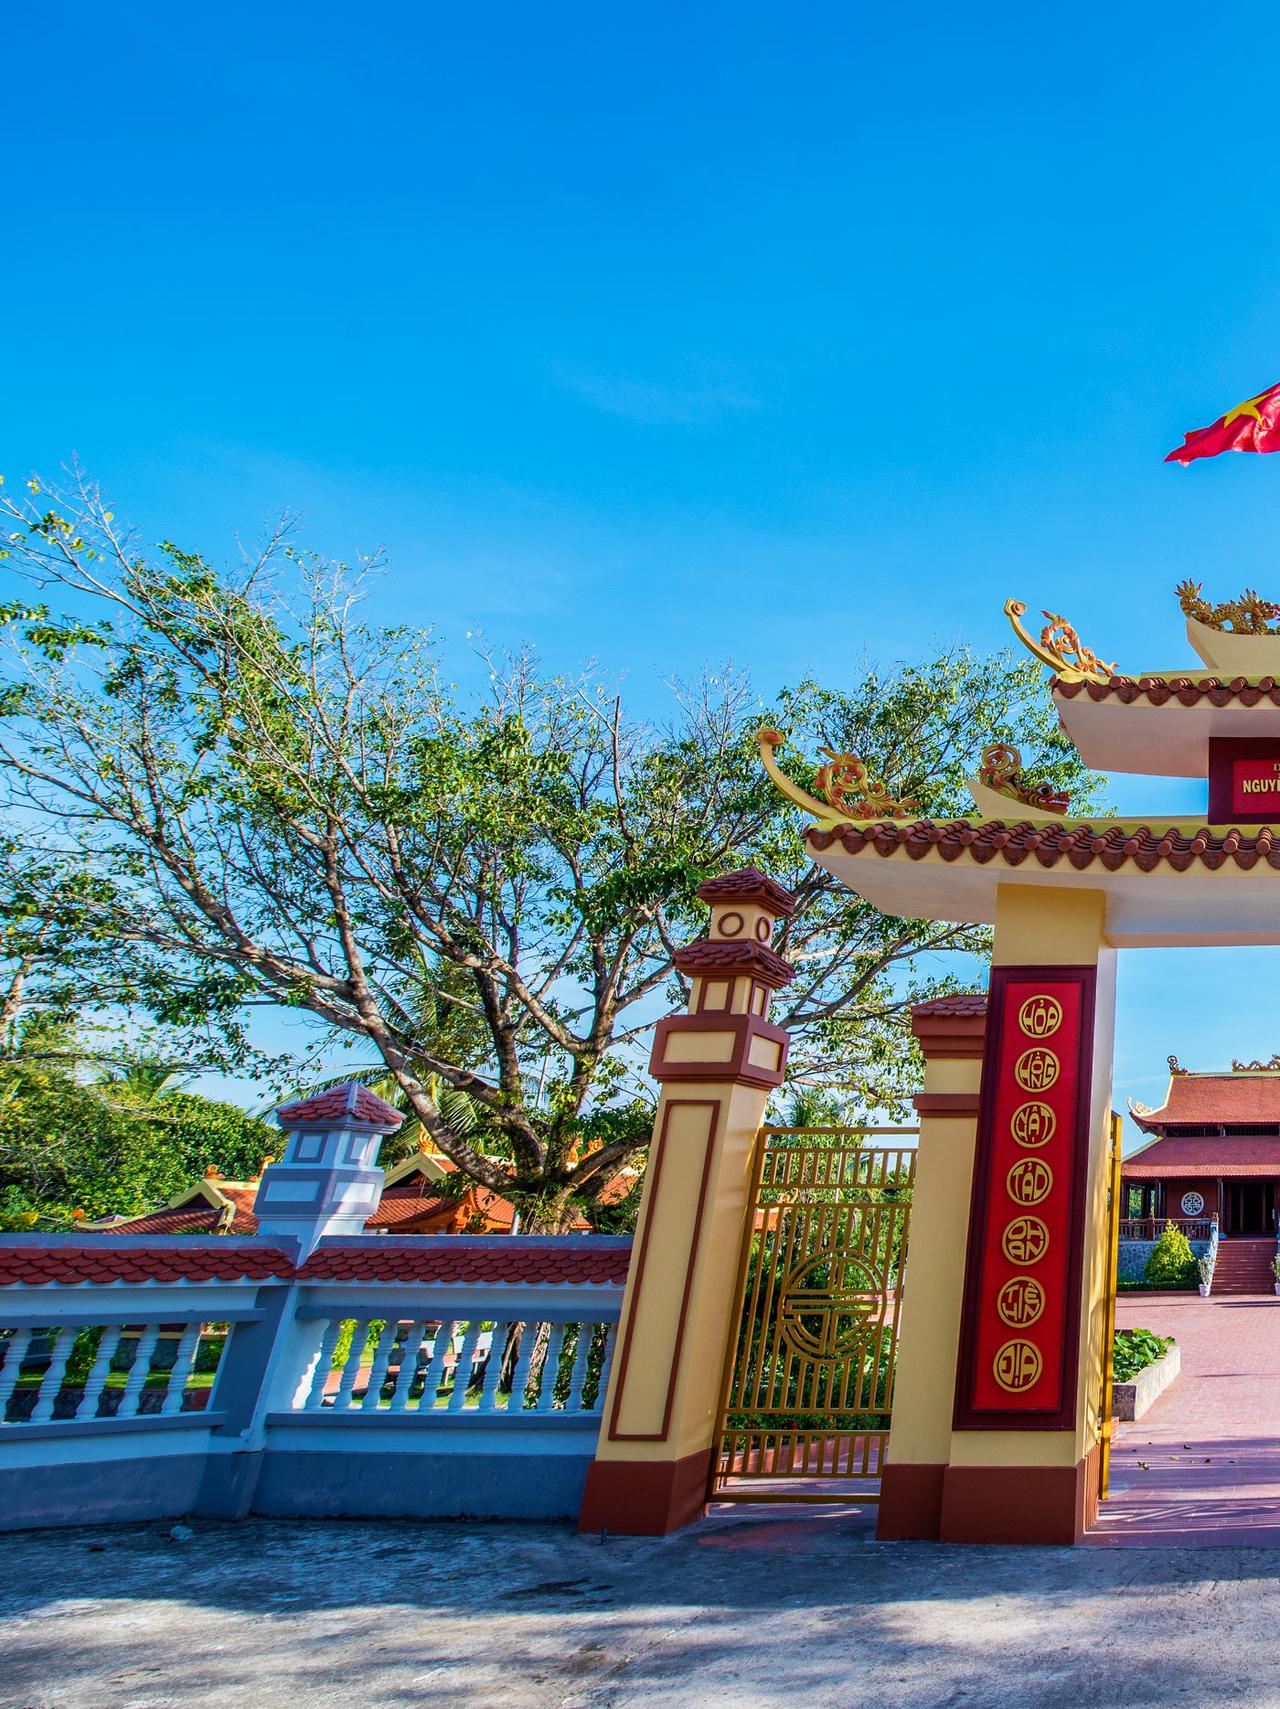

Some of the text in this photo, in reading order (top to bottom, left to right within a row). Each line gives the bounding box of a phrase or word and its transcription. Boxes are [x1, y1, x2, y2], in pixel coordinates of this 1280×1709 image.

[1023, 999, 1058, 1035] HỎA
[1019, 1051, 1056, 1089] HỒNG
[1012, 1162, 1048, 1201] TẢO
[998, 1343, 1038, 1387] ĐỊA
